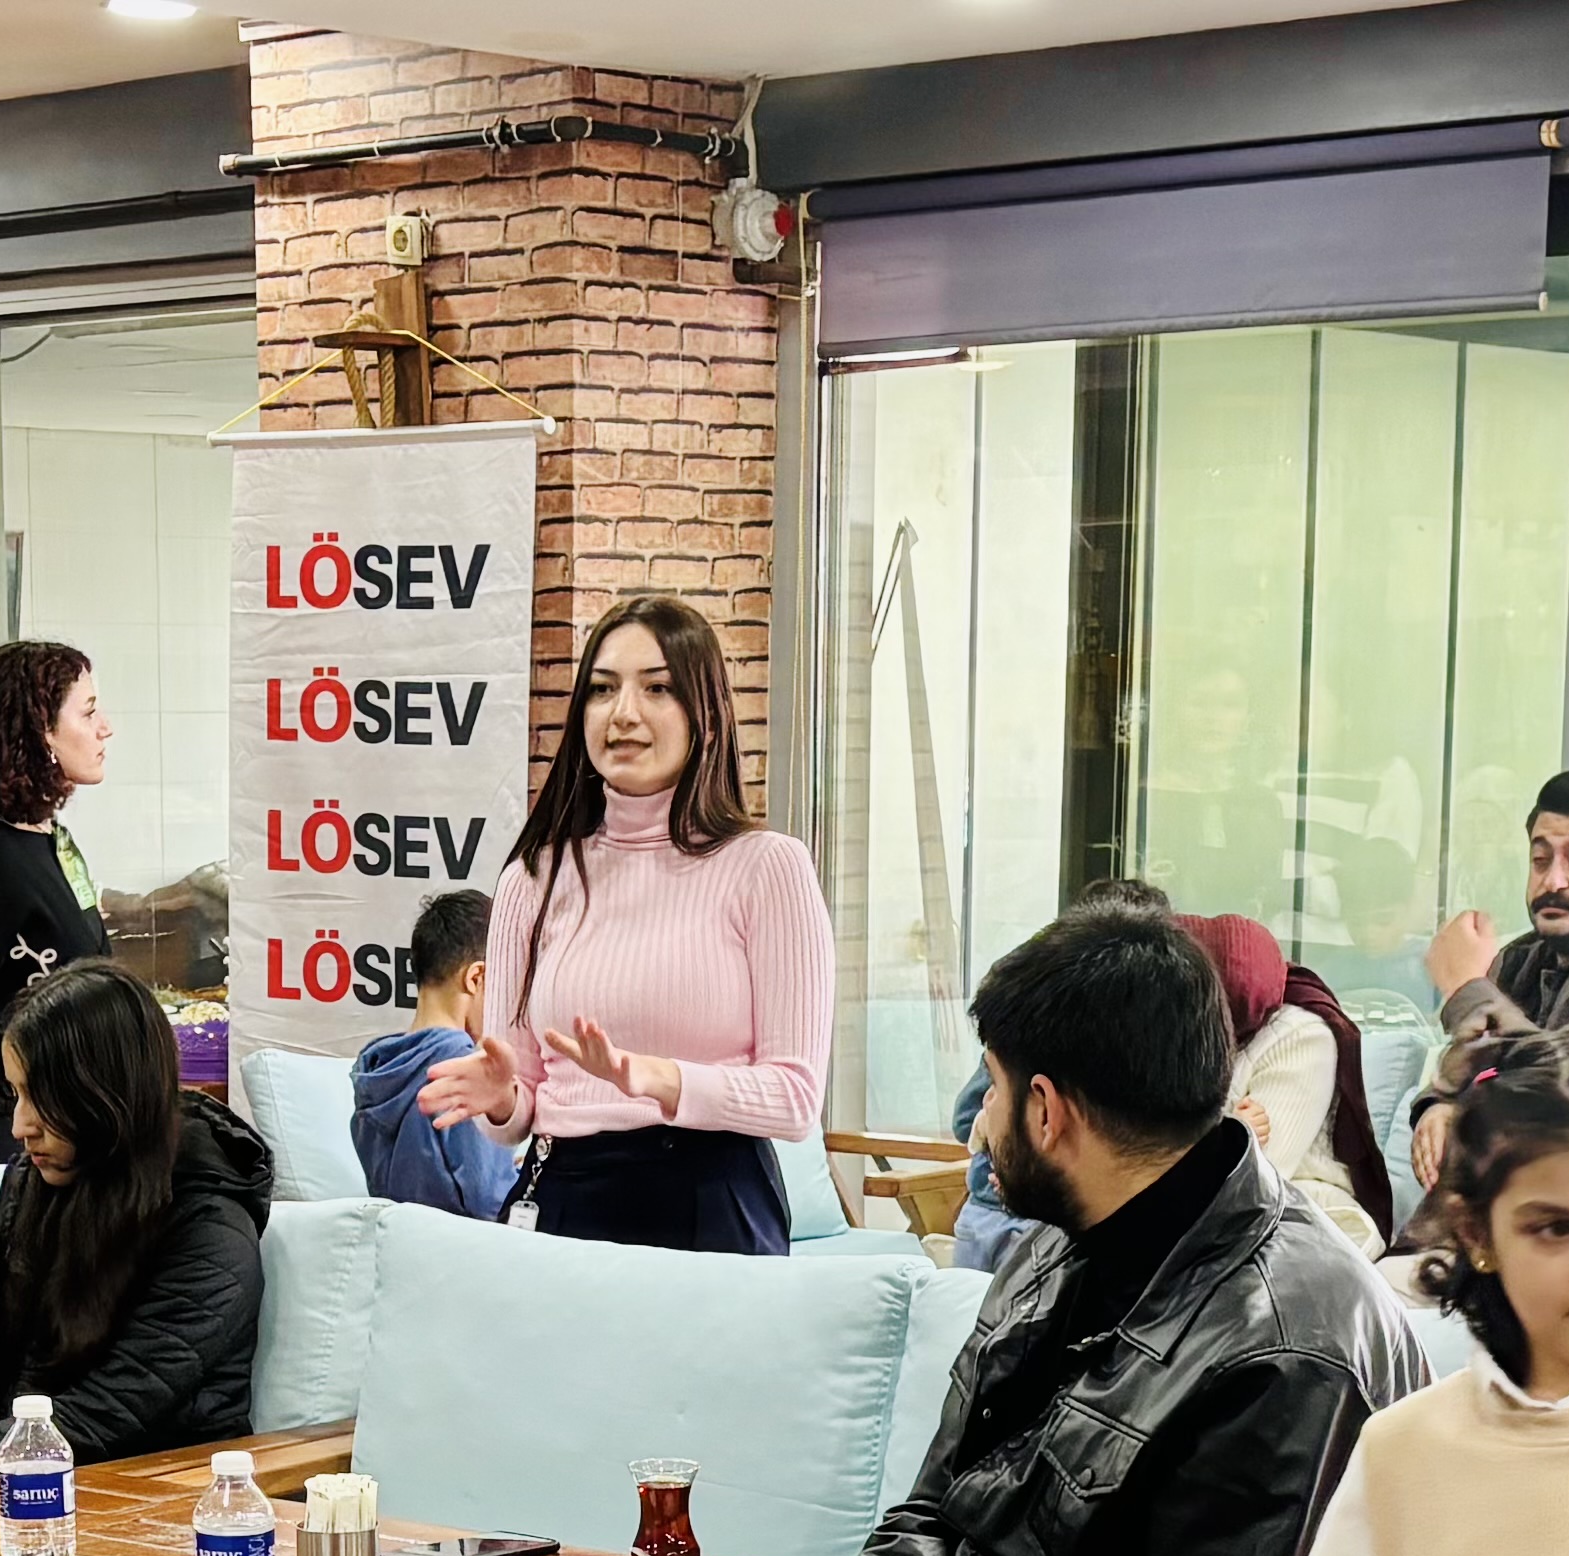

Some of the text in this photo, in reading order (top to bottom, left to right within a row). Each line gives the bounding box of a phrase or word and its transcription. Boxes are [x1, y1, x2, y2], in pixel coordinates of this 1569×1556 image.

[266, 532, 491, 610] LÖSEV
[266, 666, 488, 746] LÖSEV
[267, 799, 487, 880] LÖSEV
[267, 929, 419, 1010] LÖSE
